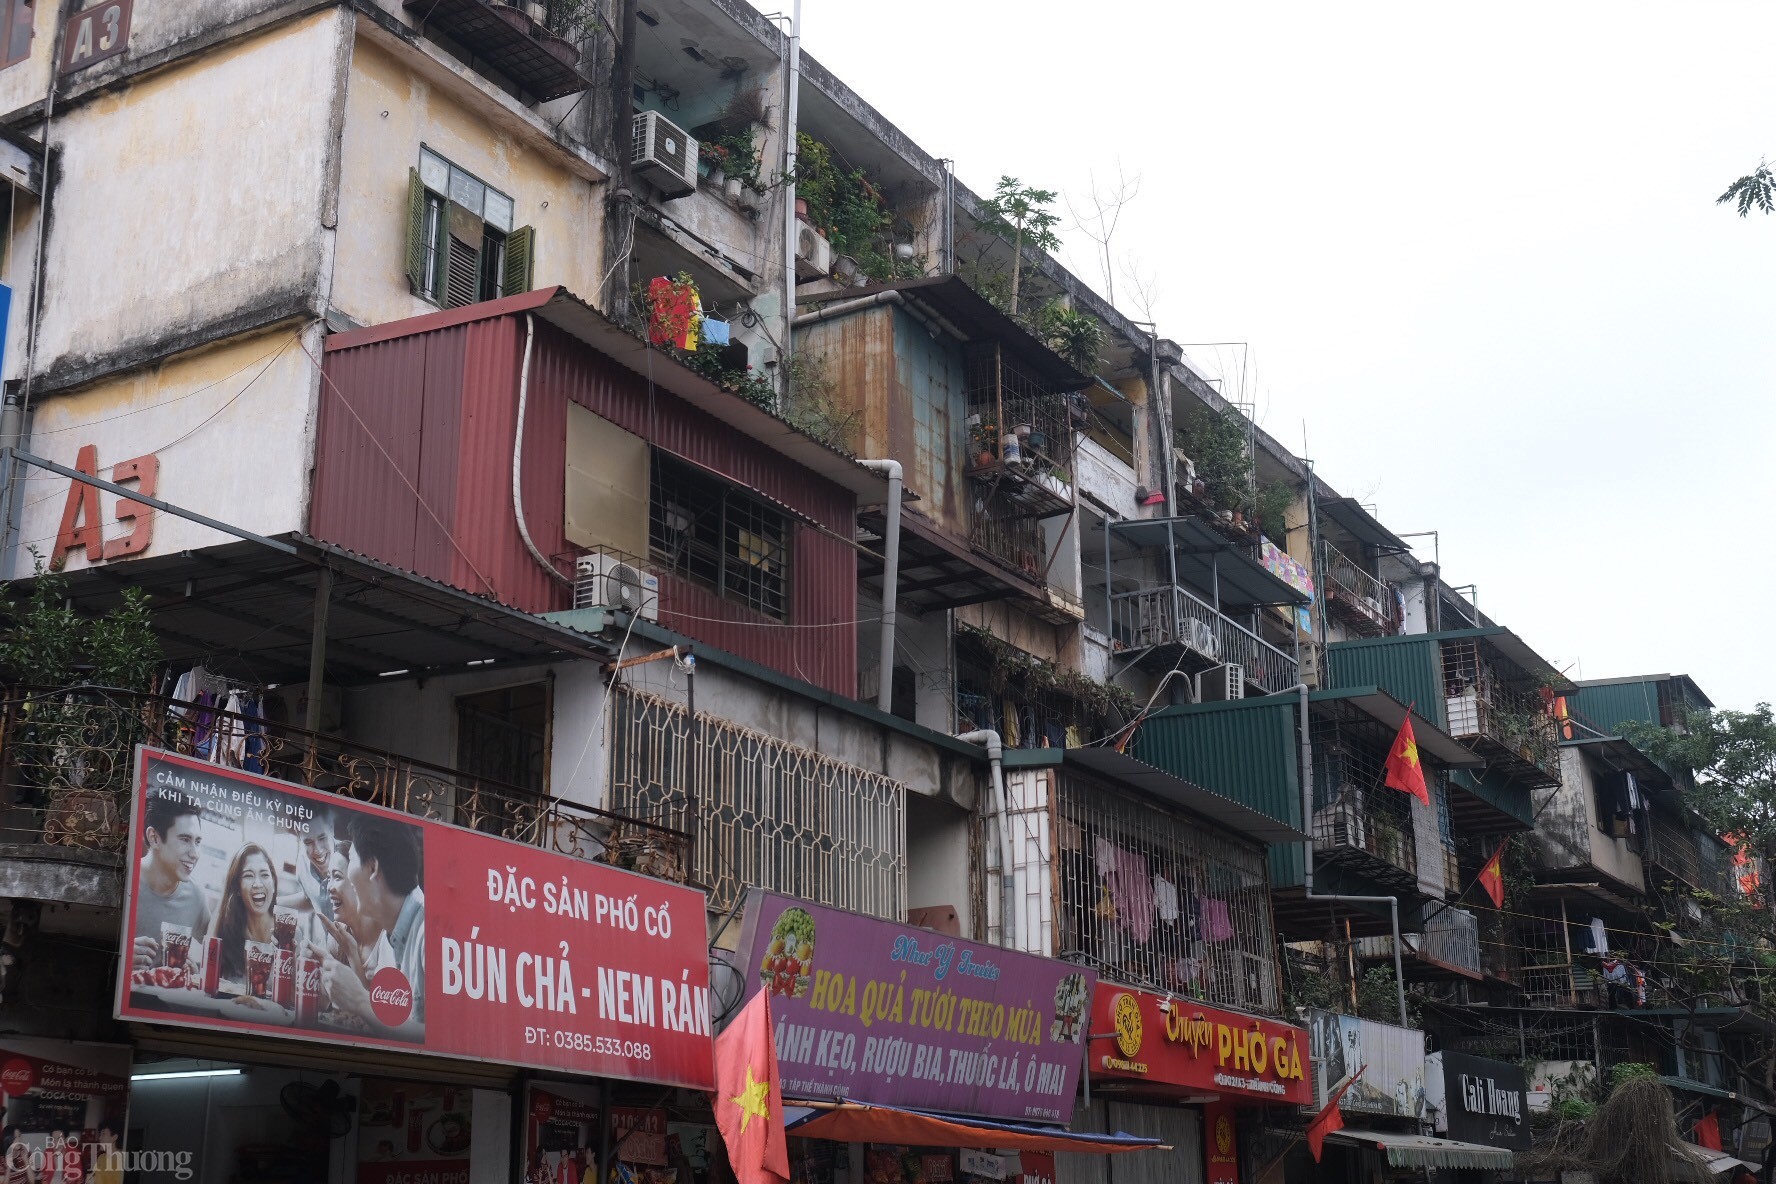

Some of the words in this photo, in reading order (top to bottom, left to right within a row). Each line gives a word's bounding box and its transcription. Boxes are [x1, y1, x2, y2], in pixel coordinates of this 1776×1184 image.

[70, 5, 121, 63] A3
[49, 444, 160, 571] A3
[156, 771, 186, 789] CẢM
[190, 781, 227, 799] NHẬN
[265, 798, 281, 812] KỲ
[285, 804, 313, 820] DIỆU
[158, 787, 182, 803] KHI
[186, 795, 202, 808] TA
[206, 797, 242, 817] CÙNG
[246, 806, 263, 822] ĂN
[267, 815, 310, 833] CHUNG
[486, 865, 536, 913] ĐẶC
[543, 875, 589, 921] SẢN
[595, 894, 638, 932] PHỐ
[644, 901, 672, 939] CỔ
[441, 926, 508, 1004] BÚN
[515, 940, 576, 1015] CHẢ
[581, 987, 591, 998] -
[597, 966, 655, 1027] NEM
[661, 968, 710, 1037] RÁN
[890, 934, 933, 966] Như
[934, 941, 956, 981] Ý
[957, 949, 1000, 981] Fruits
[371, 985, 411, 1007] Coca-Cola
[809, 969, 857, 1016] HOA
[859, 969, 907, 1028] QUẢ
[908, 985, 957, 1032] TƯƠI
[957, 997, 1005, 1040] THEO
[1004, 1000, 1042, 1046] MÙA
[525, 1026, 550, 1047] ĐT:
[554, 1030, 651, 1061] 0385.533.088
[774, 1014, 816, 1066] ÁNH
[815, 1029, 857, 1077] KẸO,
[861, 1035, 913, 1084] RƯỢU
[946, 1042, 999, 1087] THUỐC
[998, 1051, 1021, 1095] LÁ,
[1023, 1053, 1037, 1093] Ô
[1036, 1062, 1067, 1097] MAI
[1165, 1003, 1213, 1059] Chuyên
[1217, 1021, 1268, 1074] PHỞ
[1273, 1030, 1304, 1081] GÀ
[40, 1077, 61, 1087] Món
[1462, 1073, 1485, 1114] Cali
